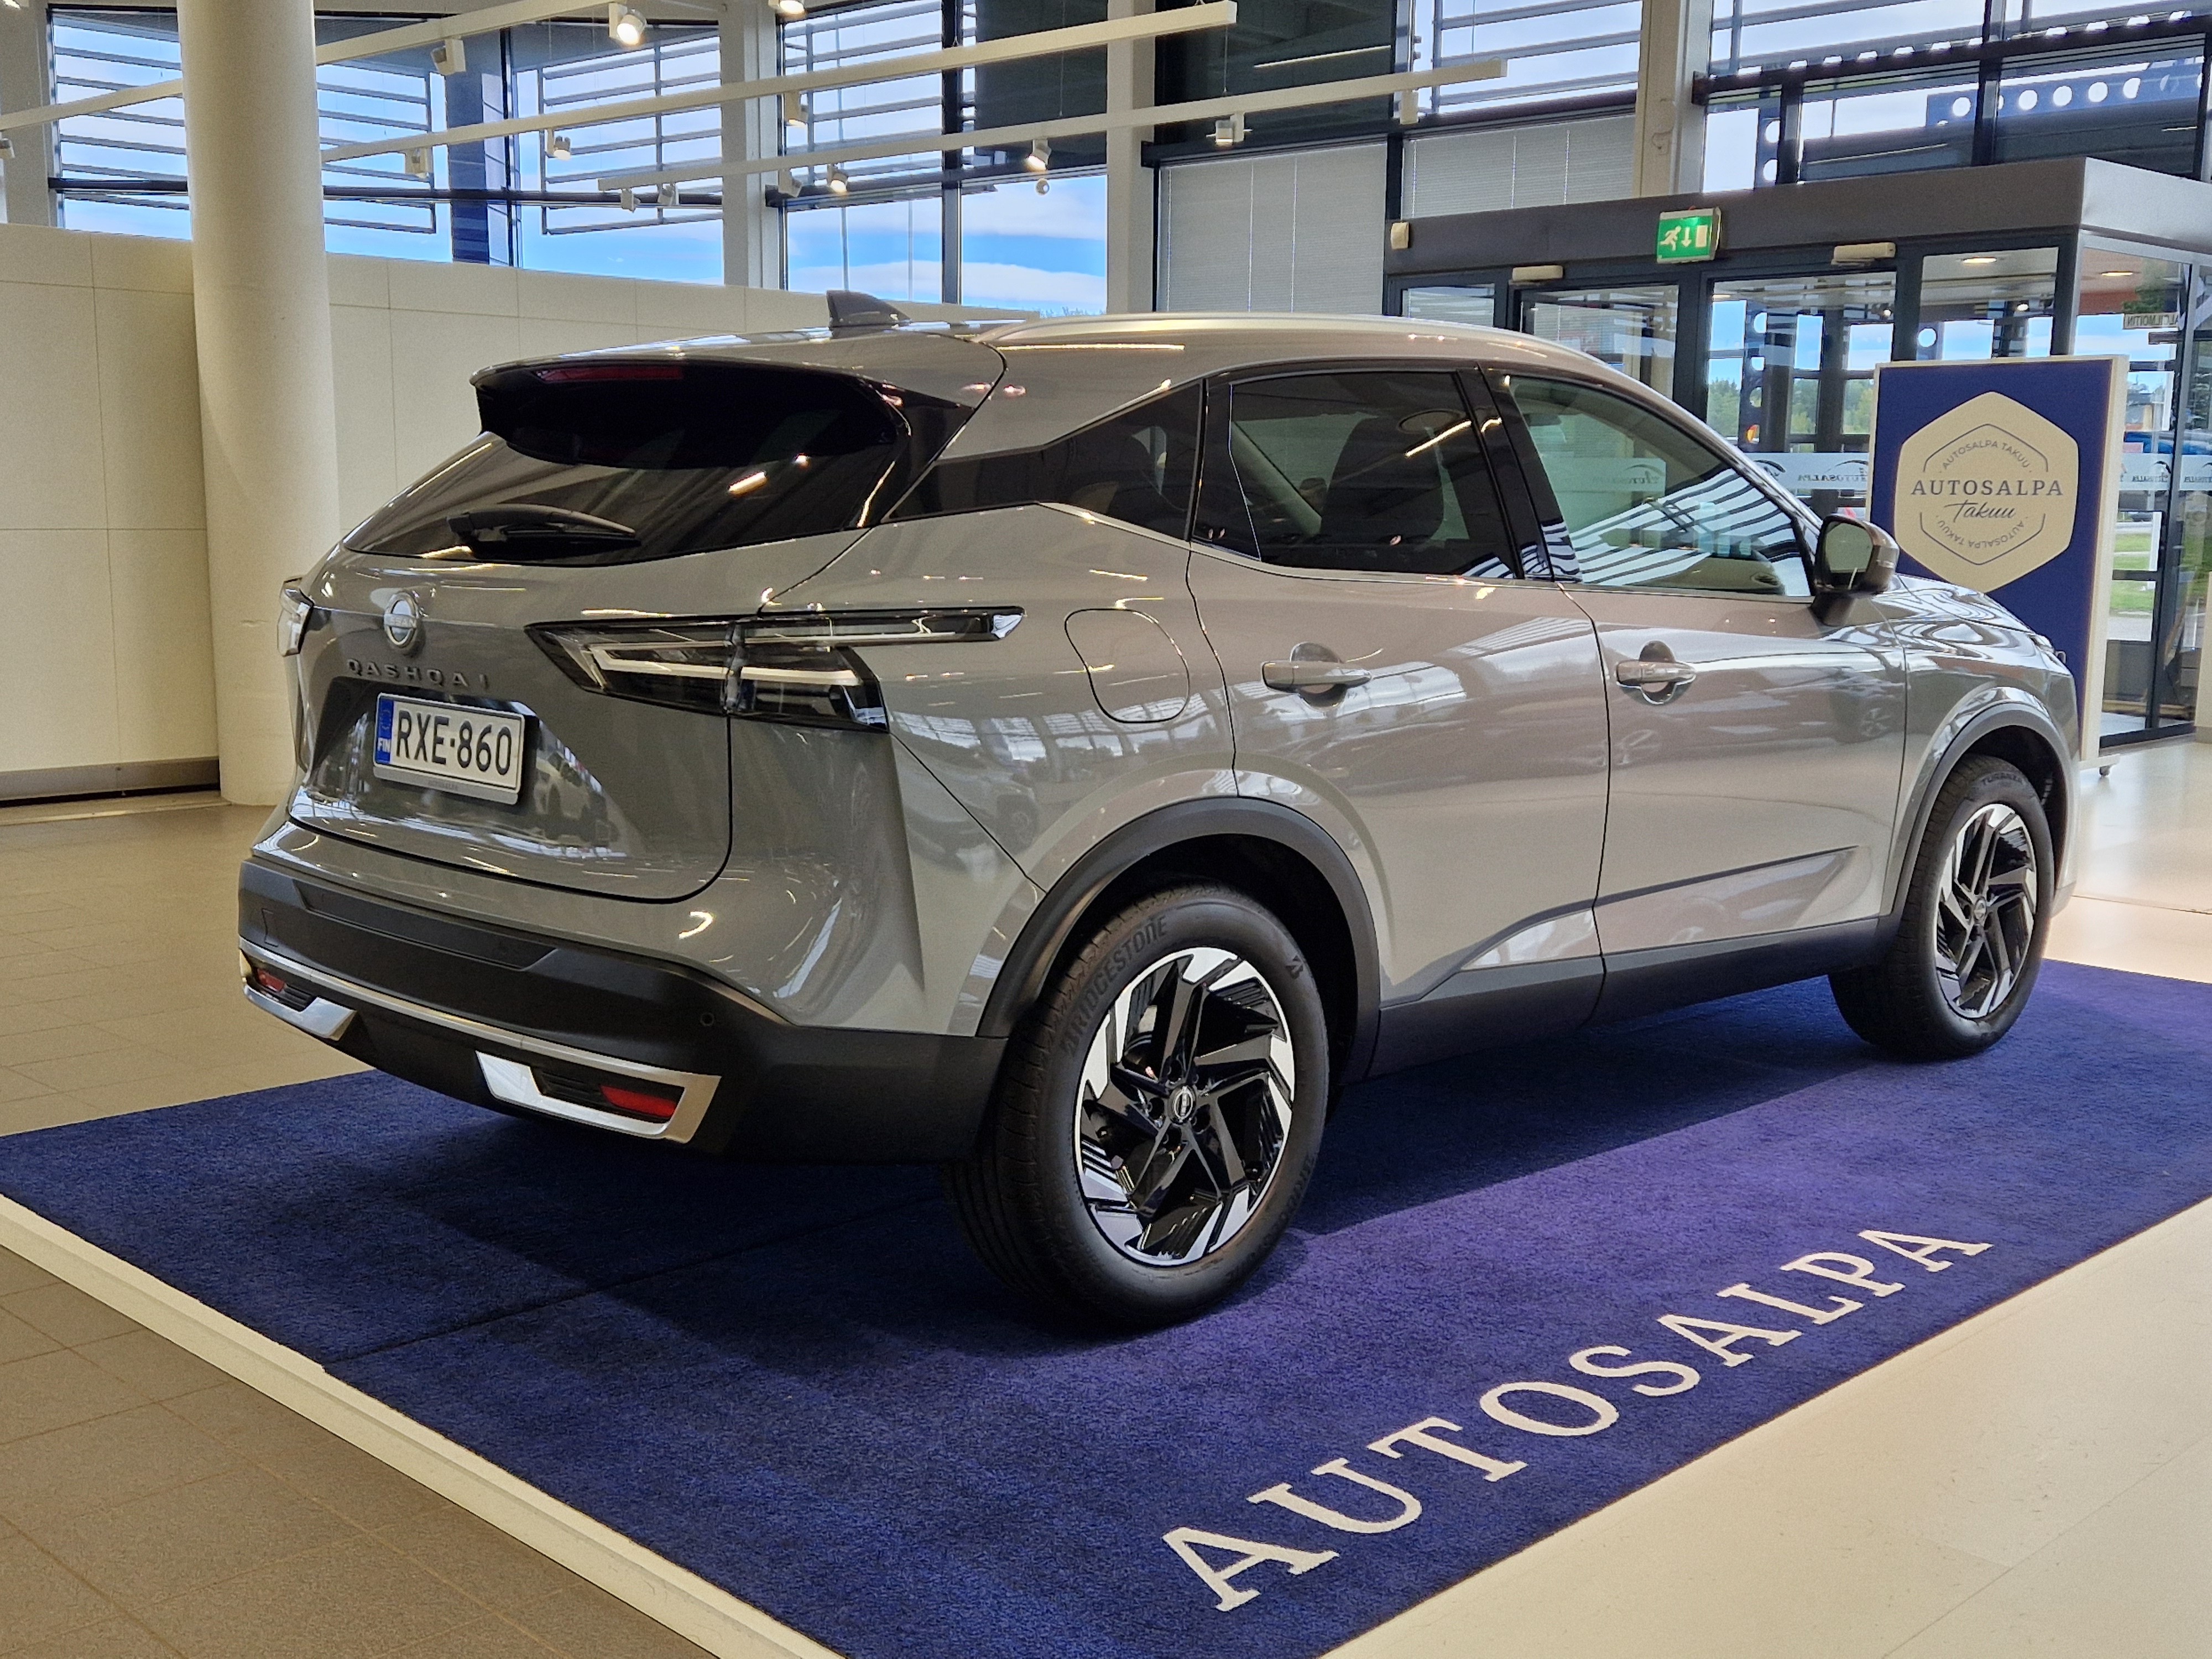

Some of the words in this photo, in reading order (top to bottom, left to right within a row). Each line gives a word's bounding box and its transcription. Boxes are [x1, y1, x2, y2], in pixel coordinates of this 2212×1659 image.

[1942, 440, 1998, 469] AUTOSALPA
[2002, 443, 2031, 468] TAKUU
[1911, 479, 2063, 496] AUTOSALPA
[1944, 499, 2016, 523] Takuu
[1938, 520, 1964, 545] TAKUU
[1969, 520, 2025, 548] AUTOSALPA
[385, 615, 417, 628] SSAN
[347, 659, 490, 690] QASHQAI
[377, 737, 391, 753] FIN
[395, 709, 512, 775] RXE-860
[1060, 914, 1167, 1057] BRIDGESTONE
[1162, 1229, 1994, 1612] AUTOSALPA
